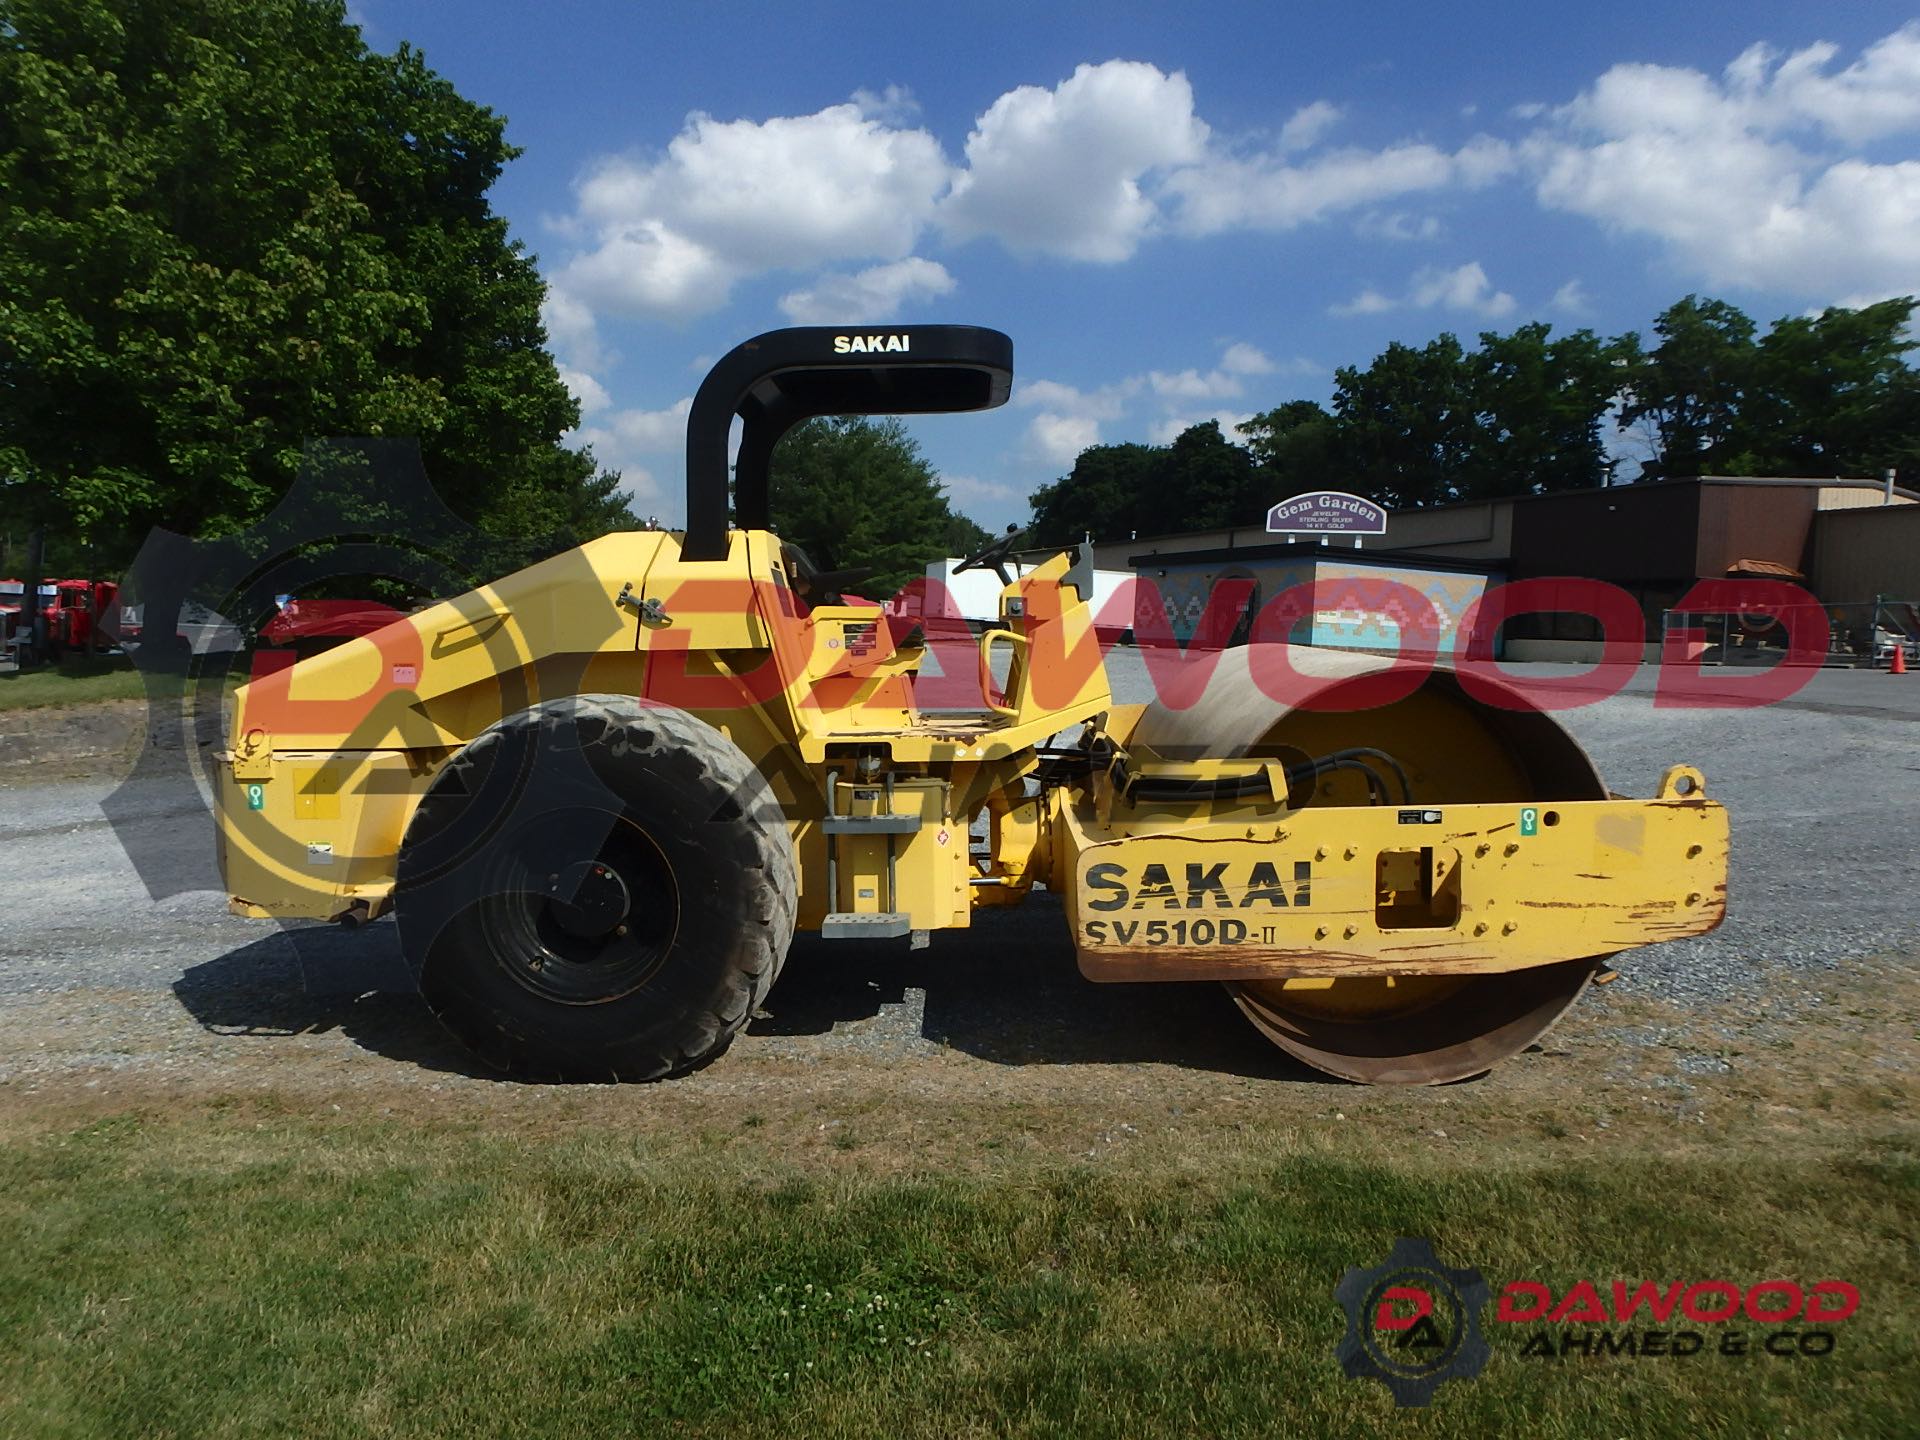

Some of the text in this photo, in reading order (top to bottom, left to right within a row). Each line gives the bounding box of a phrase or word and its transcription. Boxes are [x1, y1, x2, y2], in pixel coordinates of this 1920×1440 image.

[834, 335, 910, 354] SAKAI
[1277, 496, 1377, 522] Gem Garden
[1086, 861, 1311, 912] SAKAI
